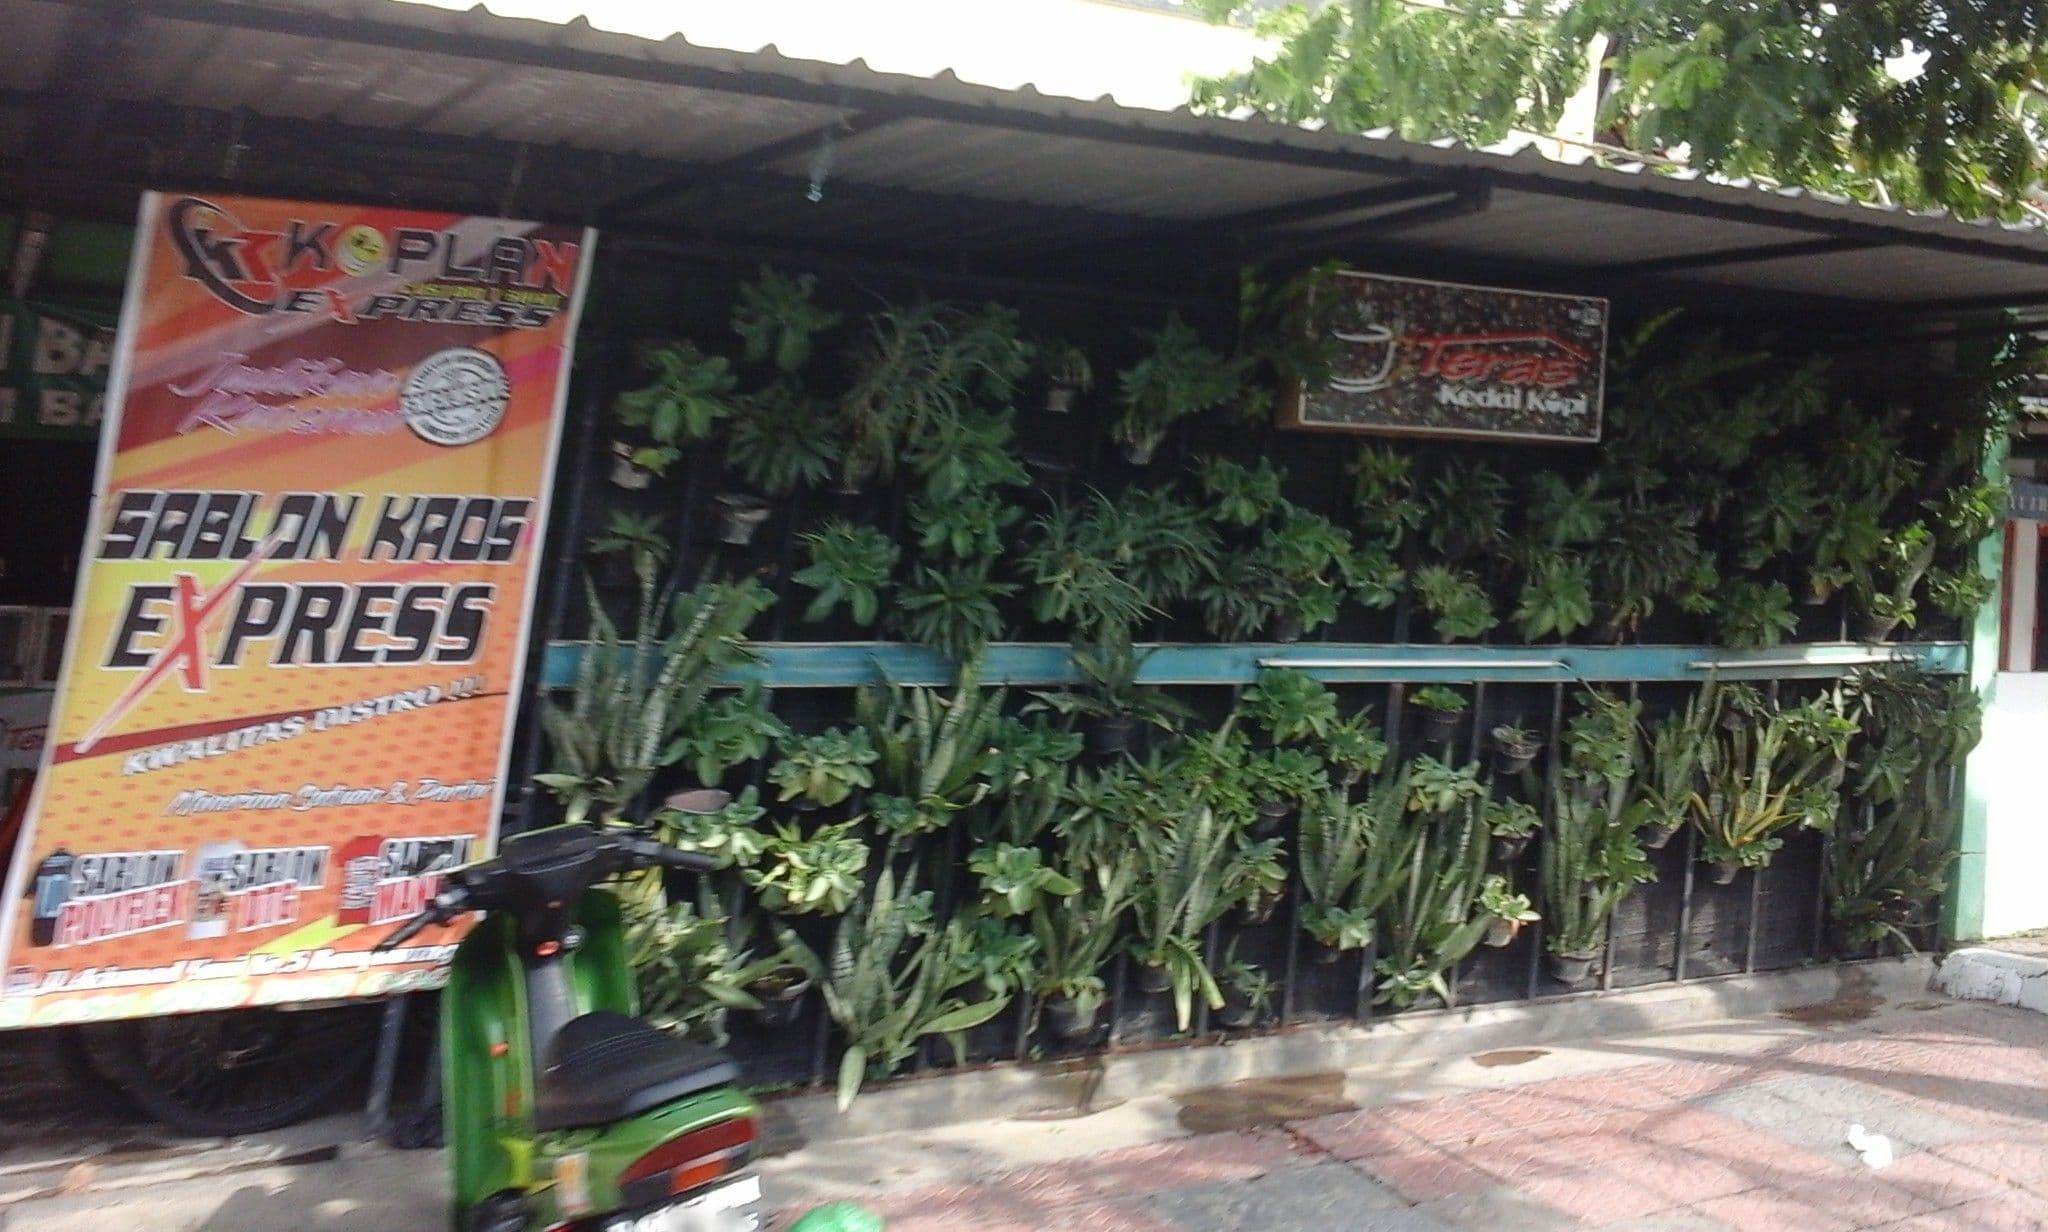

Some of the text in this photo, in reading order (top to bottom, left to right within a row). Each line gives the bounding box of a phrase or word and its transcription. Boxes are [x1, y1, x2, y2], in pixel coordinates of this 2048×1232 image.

[284, 290, 562, 327] EXPRESS
[1410, 331, 1590, 387] Teras
[98, 493, 535, 564] SABLON KAOS
[102, 574, 495, 691] EXPRESS
